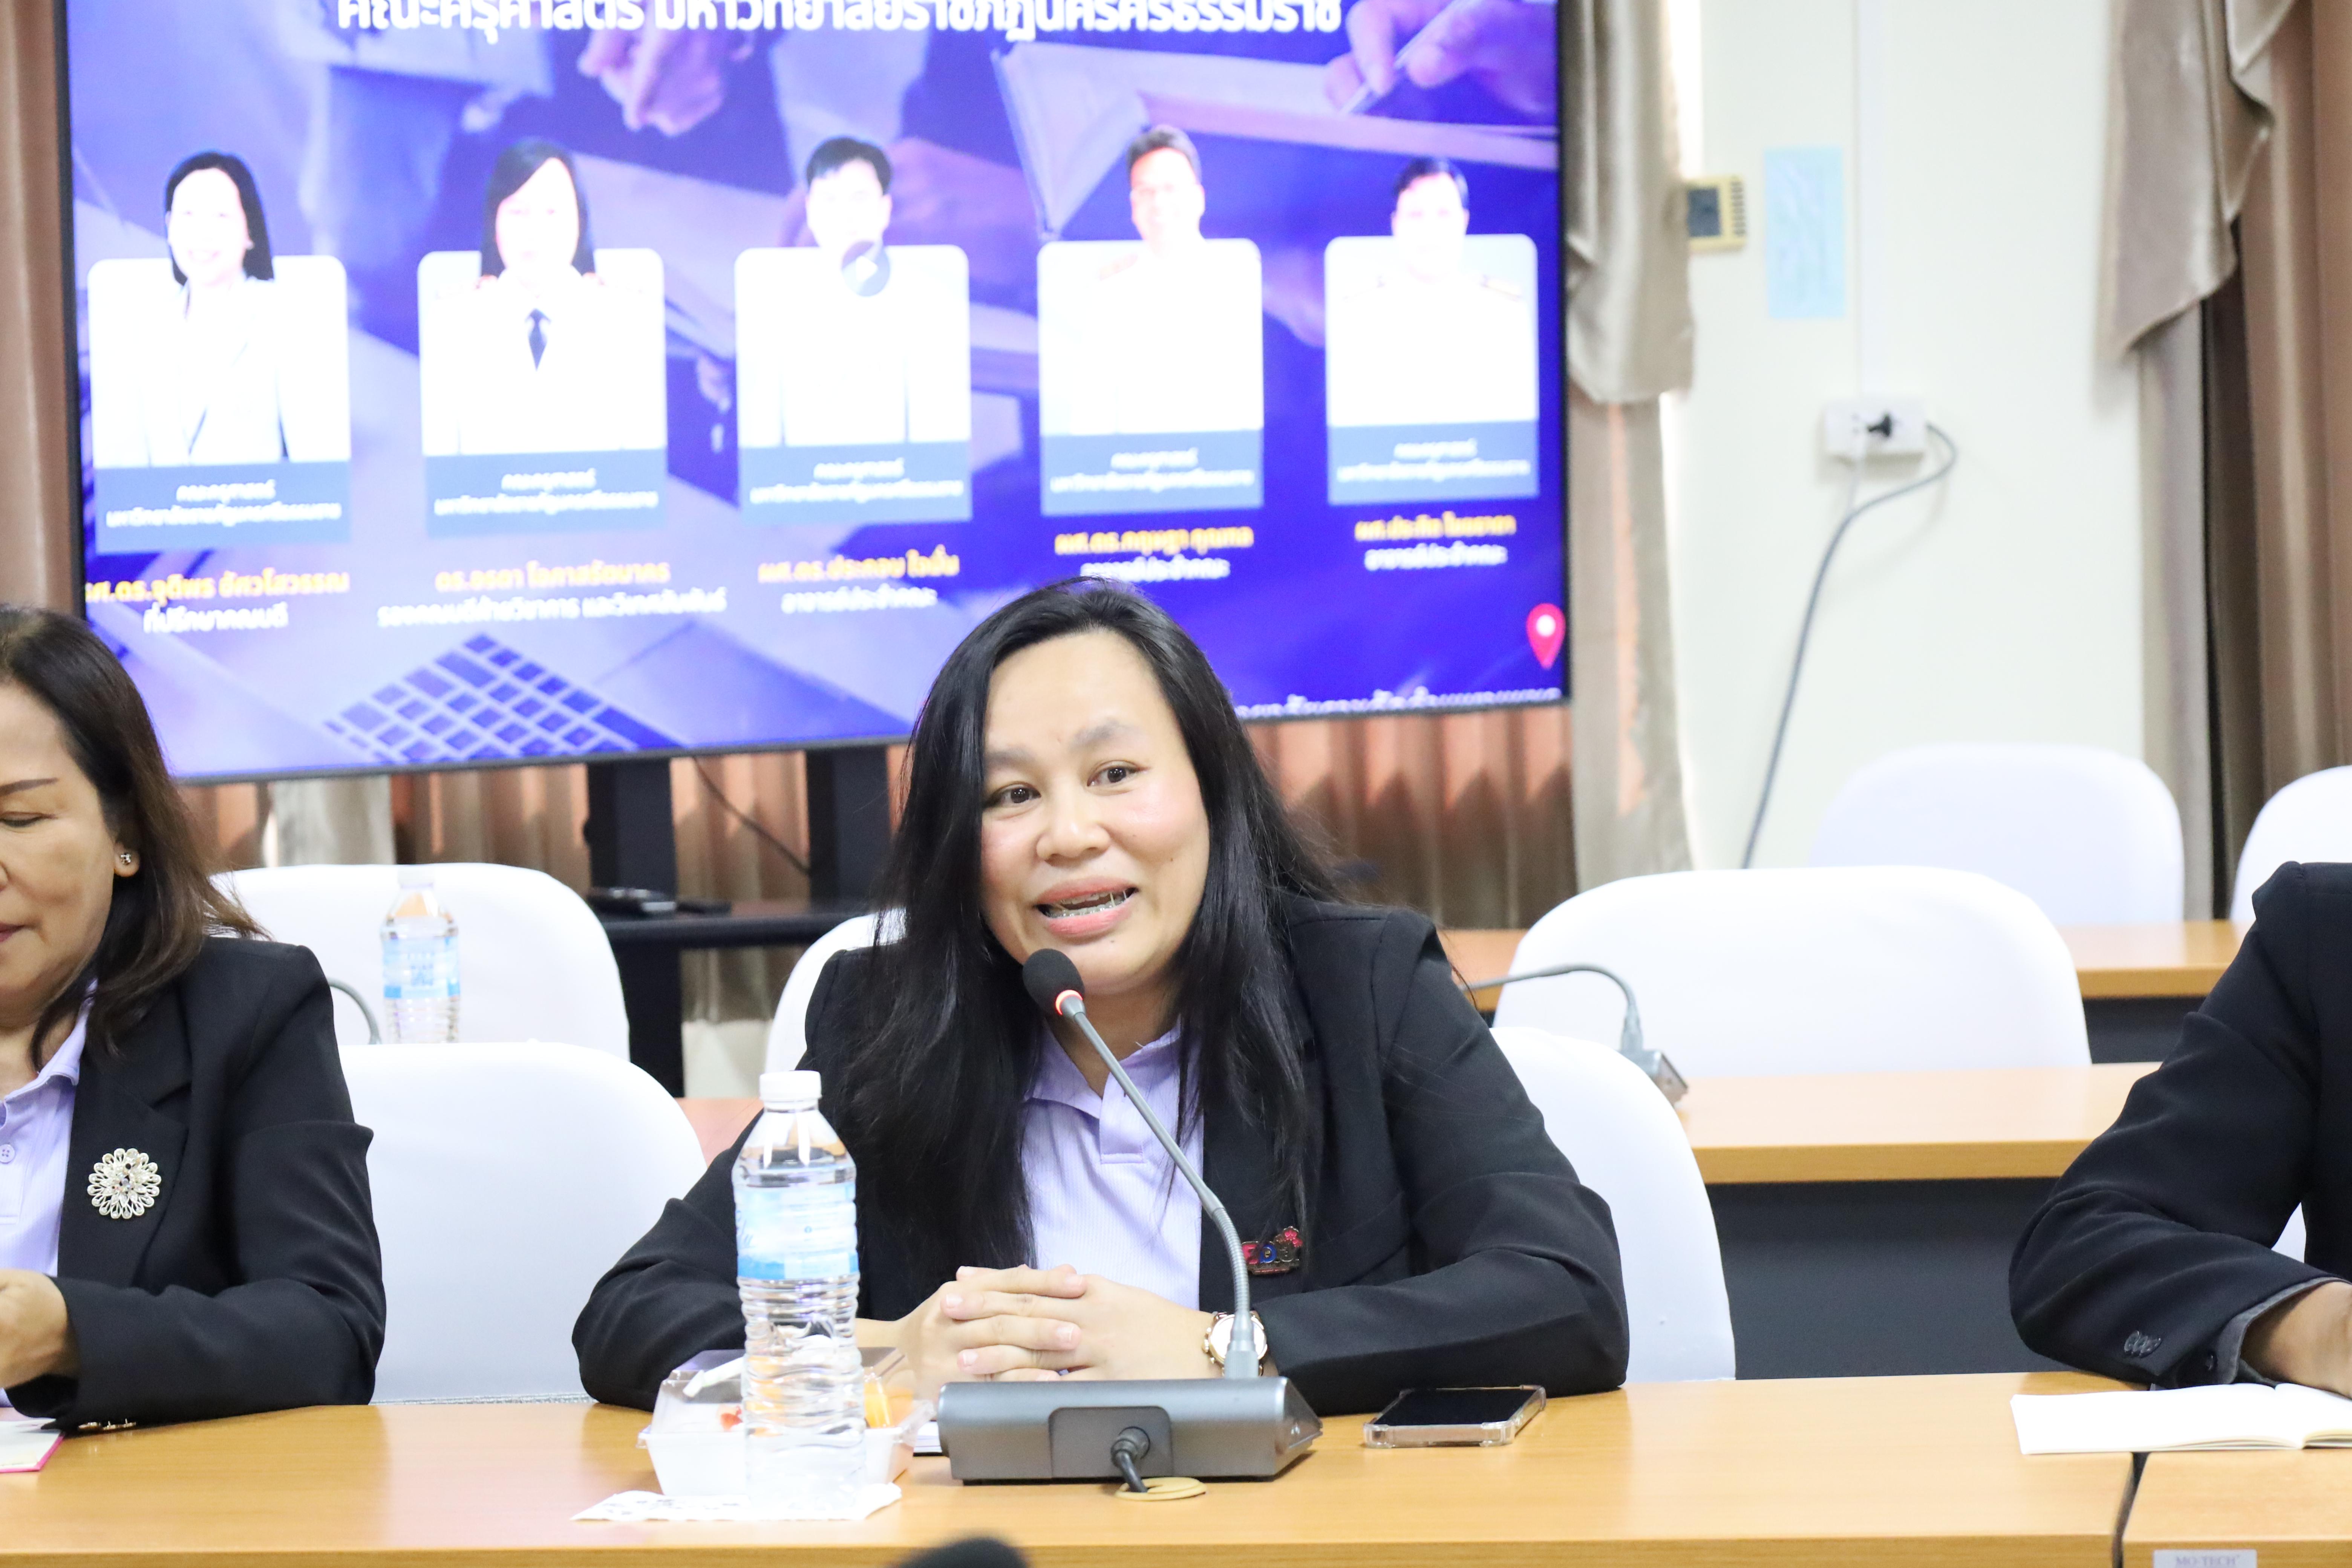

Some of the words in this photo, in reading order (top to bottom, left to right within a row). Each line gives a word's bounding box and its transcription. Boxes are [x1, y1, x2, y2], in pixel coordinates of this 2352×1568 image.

[338, 0, 645, 44] คณะครุศาสตร
[655, 0, 1343, 42] มหาวทยาลยราชภฏนครศรธรรมราช
